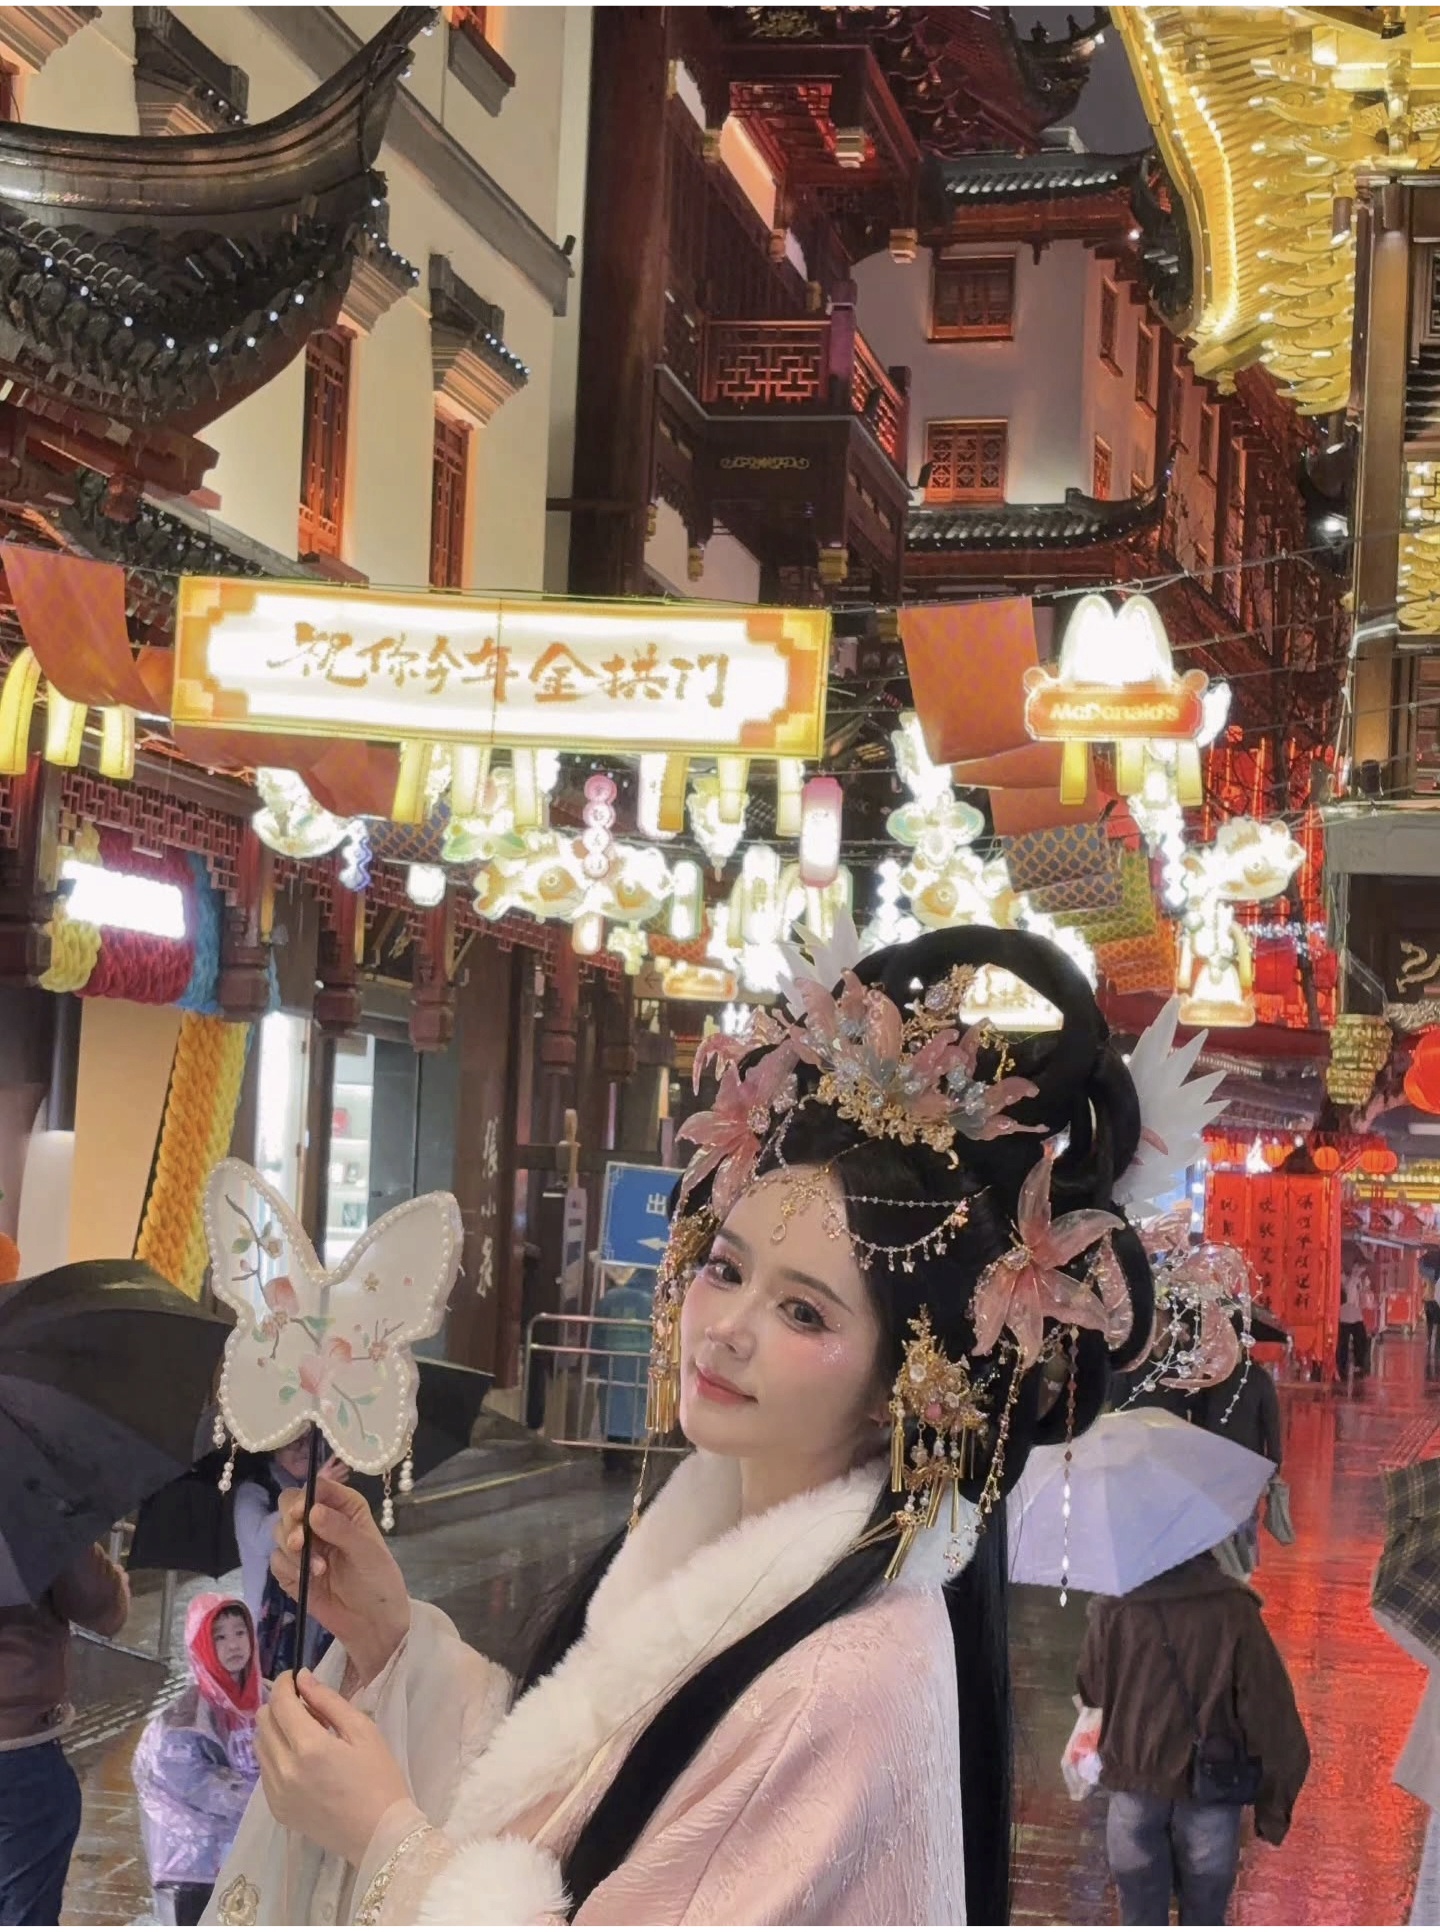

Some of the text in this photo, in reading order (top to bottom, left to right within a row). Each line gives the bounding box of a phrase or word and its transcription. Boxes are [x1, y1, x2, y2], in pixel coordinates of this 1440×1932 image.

[267, 621, 730, 707] 祝你今年金拱门
[1049, 701, 1179, 721] McDonald's
